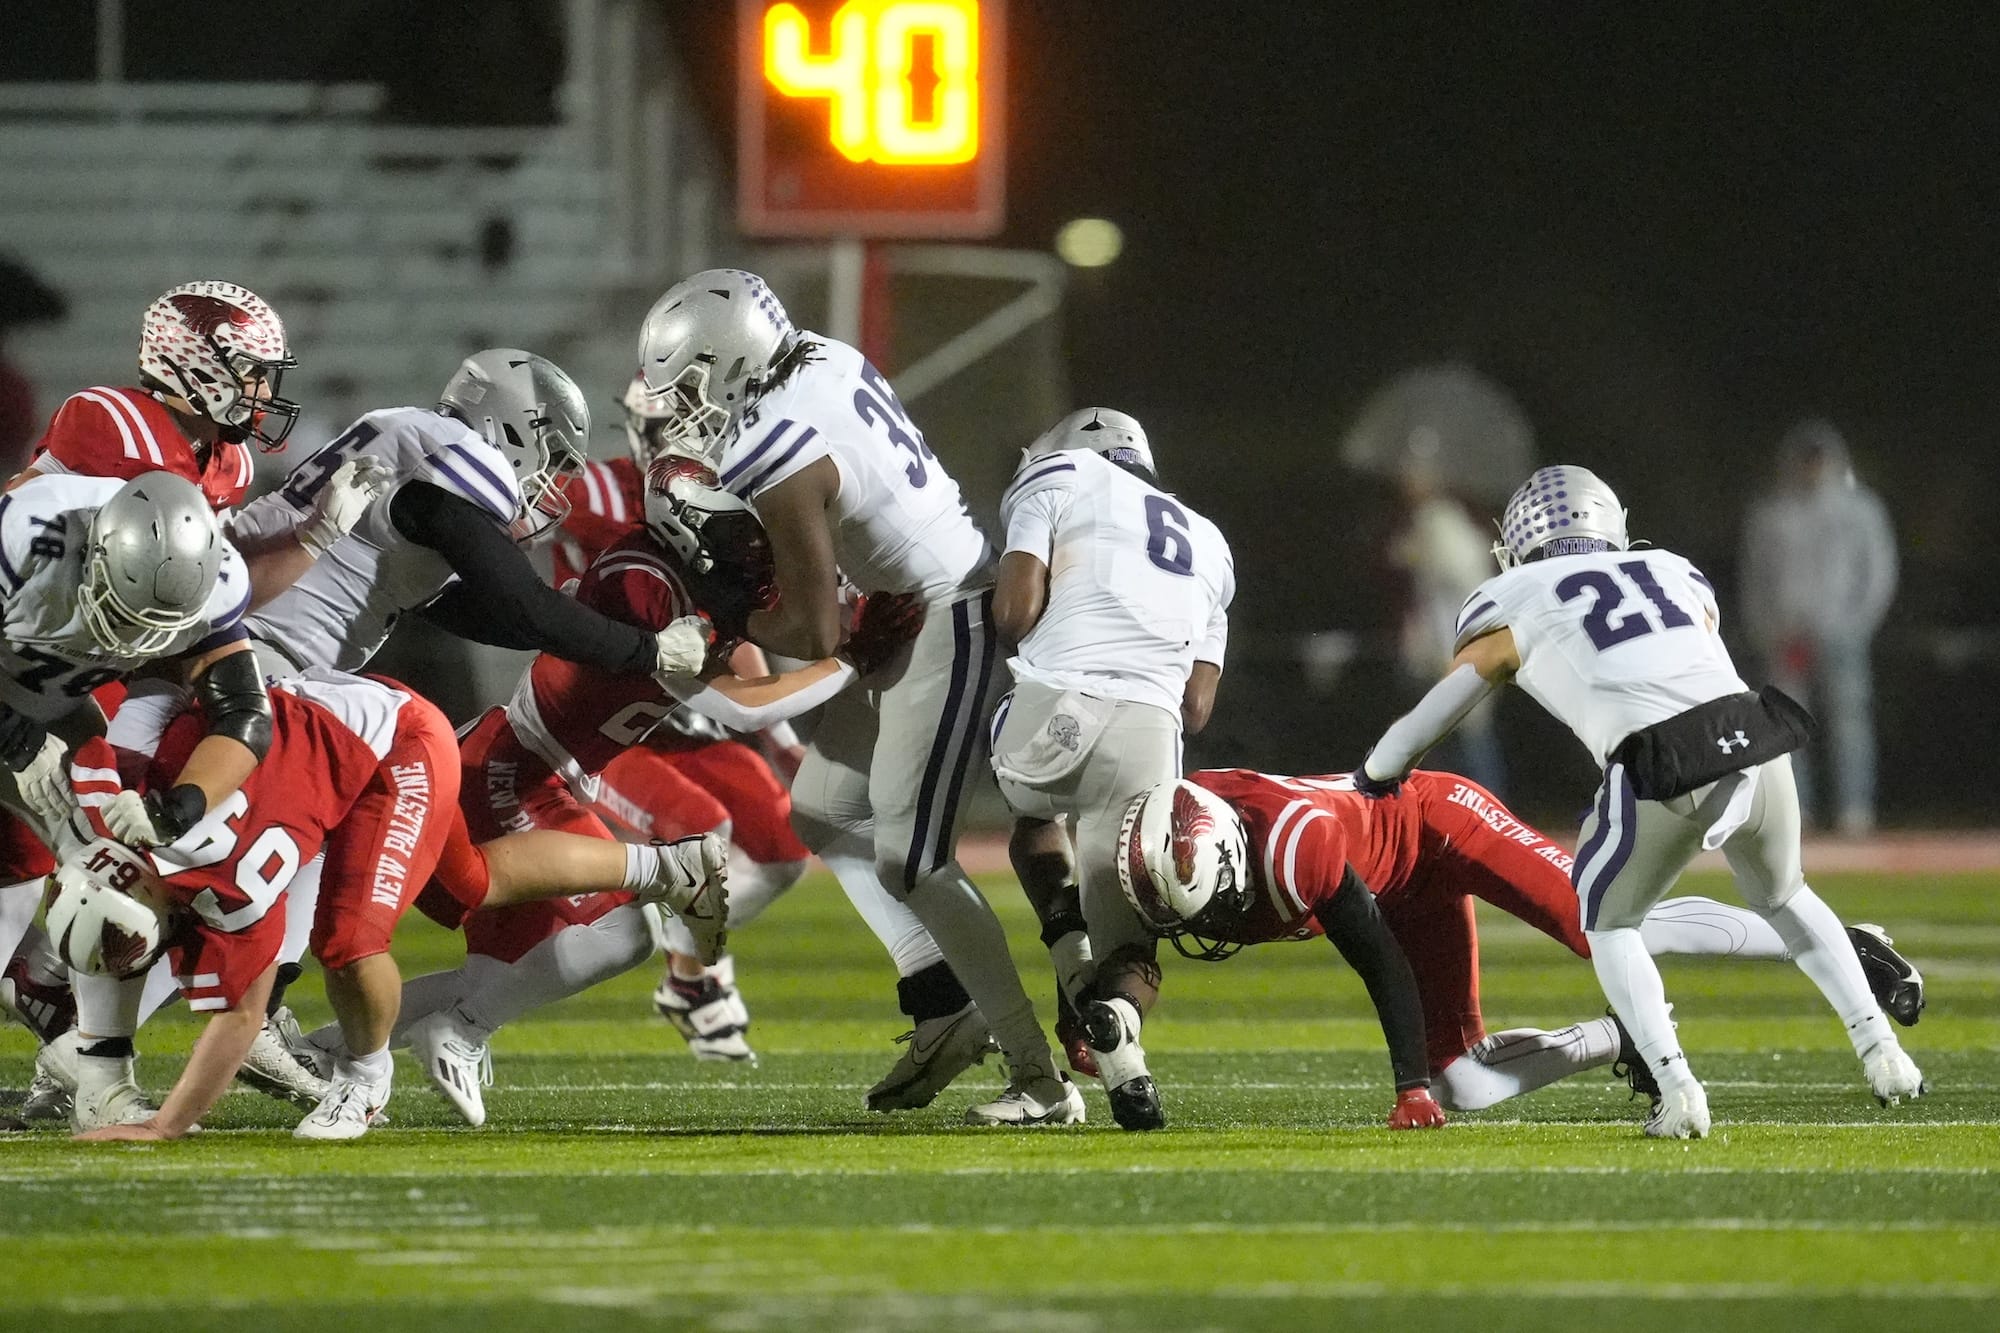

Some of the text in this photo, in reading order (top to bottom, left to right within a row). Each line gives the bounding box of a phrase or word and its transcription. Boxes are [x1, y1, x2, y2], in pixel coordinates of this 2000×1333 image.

[764, 0, 979, 165] 40
[29, 514, 67, 559] 78
[1142, 494, 1195, 577] 6
[1542, 538, 1609, 558] PANTHERS
[1553, 560, 1696, 655] 21
[487, 760, 521, 809] NEW
[1446, 783, 1545, 847] PALESTINE
[82, 847, 141, 892] 64
[149, 788, 301, 933] 64
[371, 853, 407, 910] NEW
